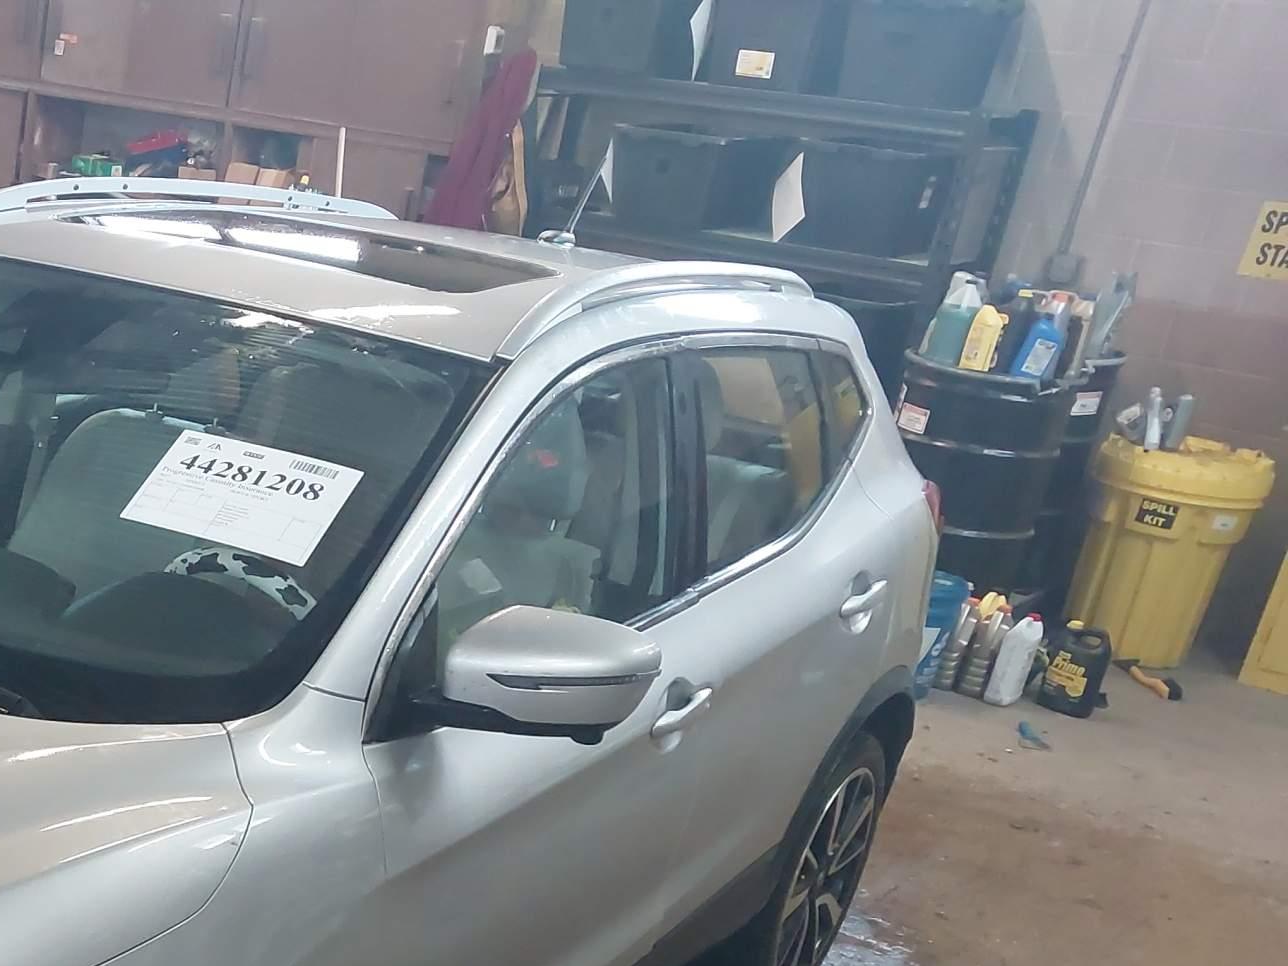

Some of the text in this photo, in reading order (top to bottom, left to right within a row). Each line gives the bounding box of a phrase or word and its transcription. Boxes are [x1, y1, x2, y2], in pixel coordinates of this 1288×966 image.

[180, 454, 324, 501] 44281208
[1142, 500, 1176, 516] SPILL
[1143, 514, 1166, 527] KIT
